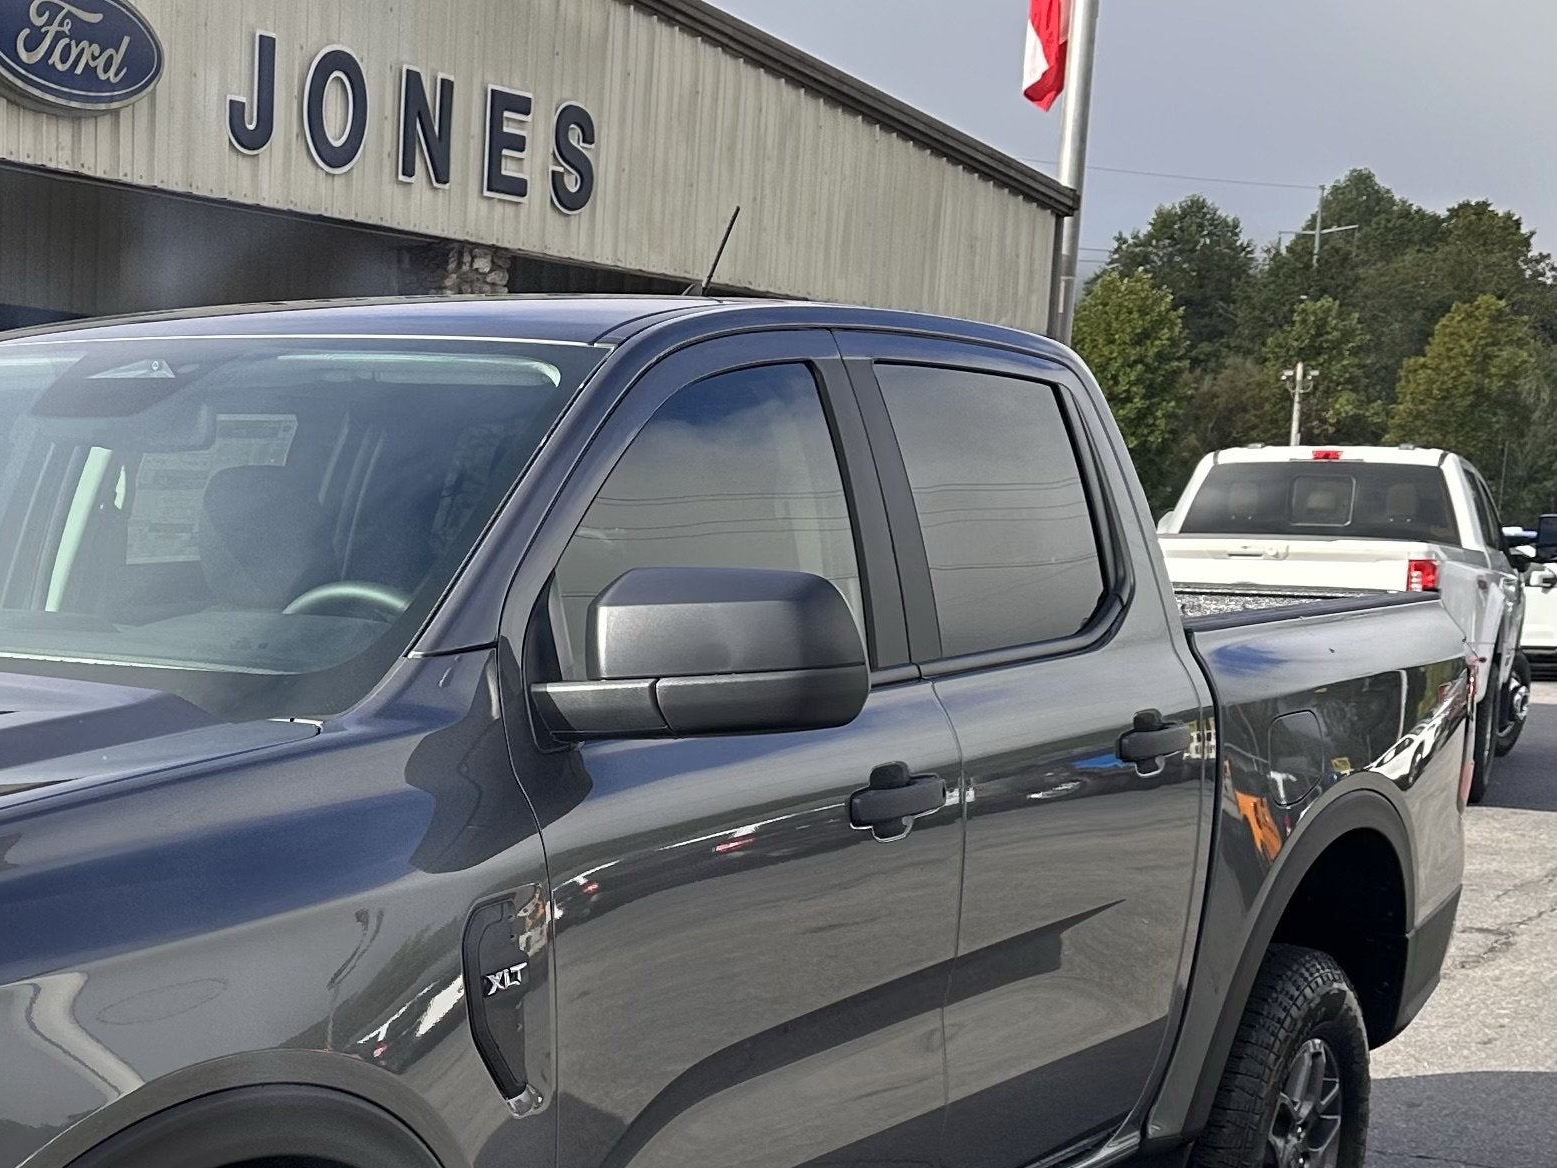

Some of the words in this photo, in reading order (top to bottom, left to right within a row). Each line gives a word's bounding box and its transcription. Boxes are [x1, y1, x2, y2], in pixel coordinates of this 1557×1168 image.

[16, 0, 130, 83] Ford
[226, 30, 596, 216] JONES
[485, 961, 528, 996] XLT
